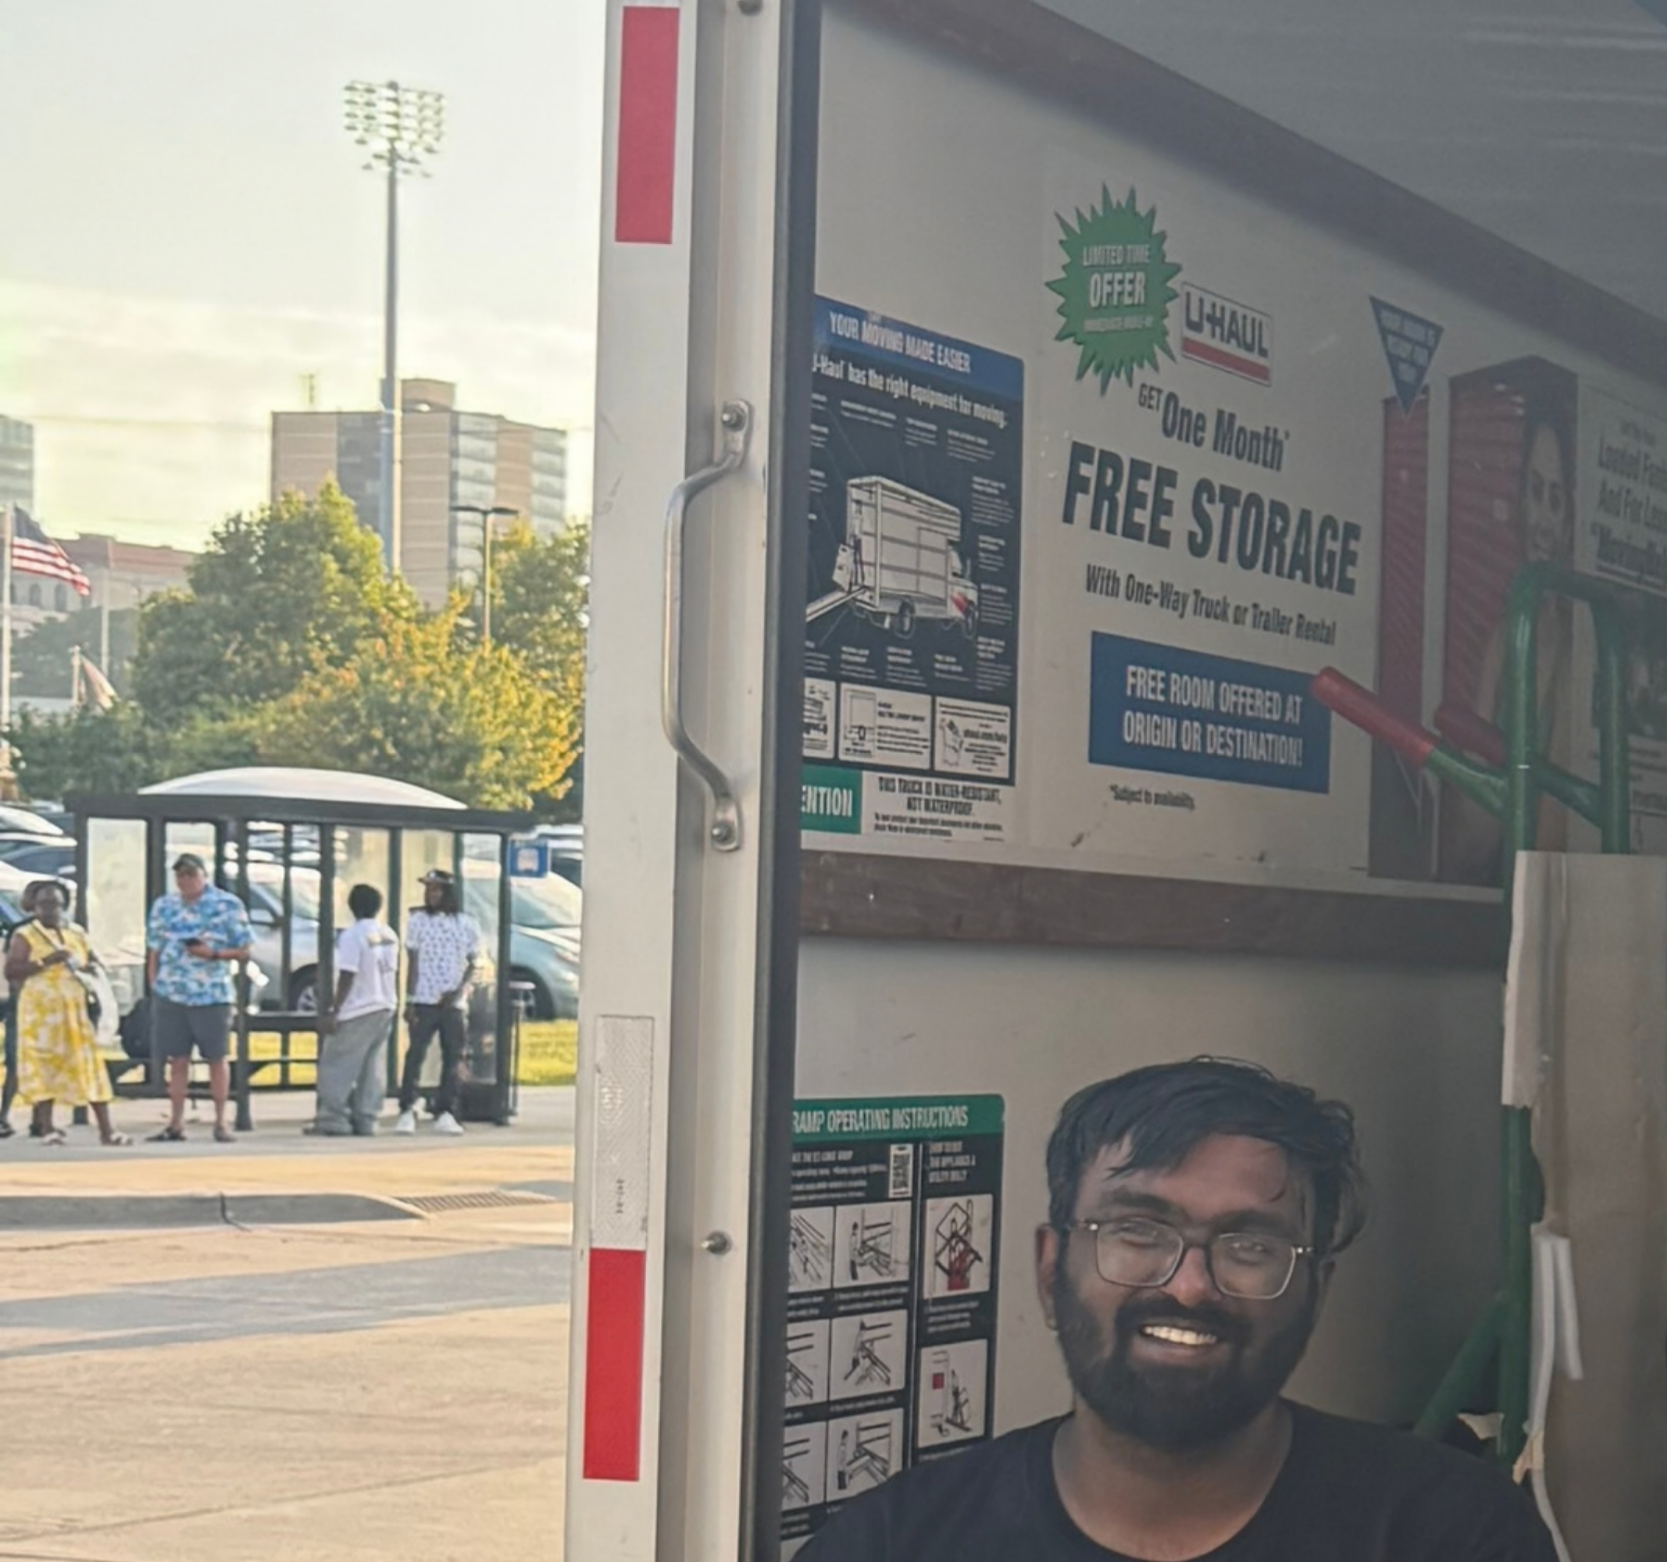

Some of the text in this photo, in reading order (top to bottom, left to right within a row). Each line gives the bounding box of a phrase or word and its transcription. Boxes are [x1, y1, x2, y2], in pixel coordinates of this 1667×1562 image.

[1090, 271, 1146, 308] OFFER
[829, 311, 971, 373] YOUR MOVING MADE EASIER
[1185, 290, 1269, 358] U-HAUL
[848, 364, 866, 386] has
[868, 369, 884, 391] the
[885, 375, 909, 398] right
[910, 385, 957, 408] equipment
[959, 395, 972, 415] for
[1139, 383, 1163, 411] GET
[1162, 391, 1206, 448] One
[1062, 440, 1178, 549] FREE
[1187, 477, 1362, 596] STORAGE
[1086, 563, 1336, 646] With One-Way Truck or Trailer Rental
[1126, 665, 1303, 724] FREE ROOM OFFERED AT
[1123, 710, 1304, 766] ORIGIN OR DESTINATION!
[828, 1108, 890, 1133] OPERATING
[892, 1106, 968, 1130] INSTRUCTIONS
